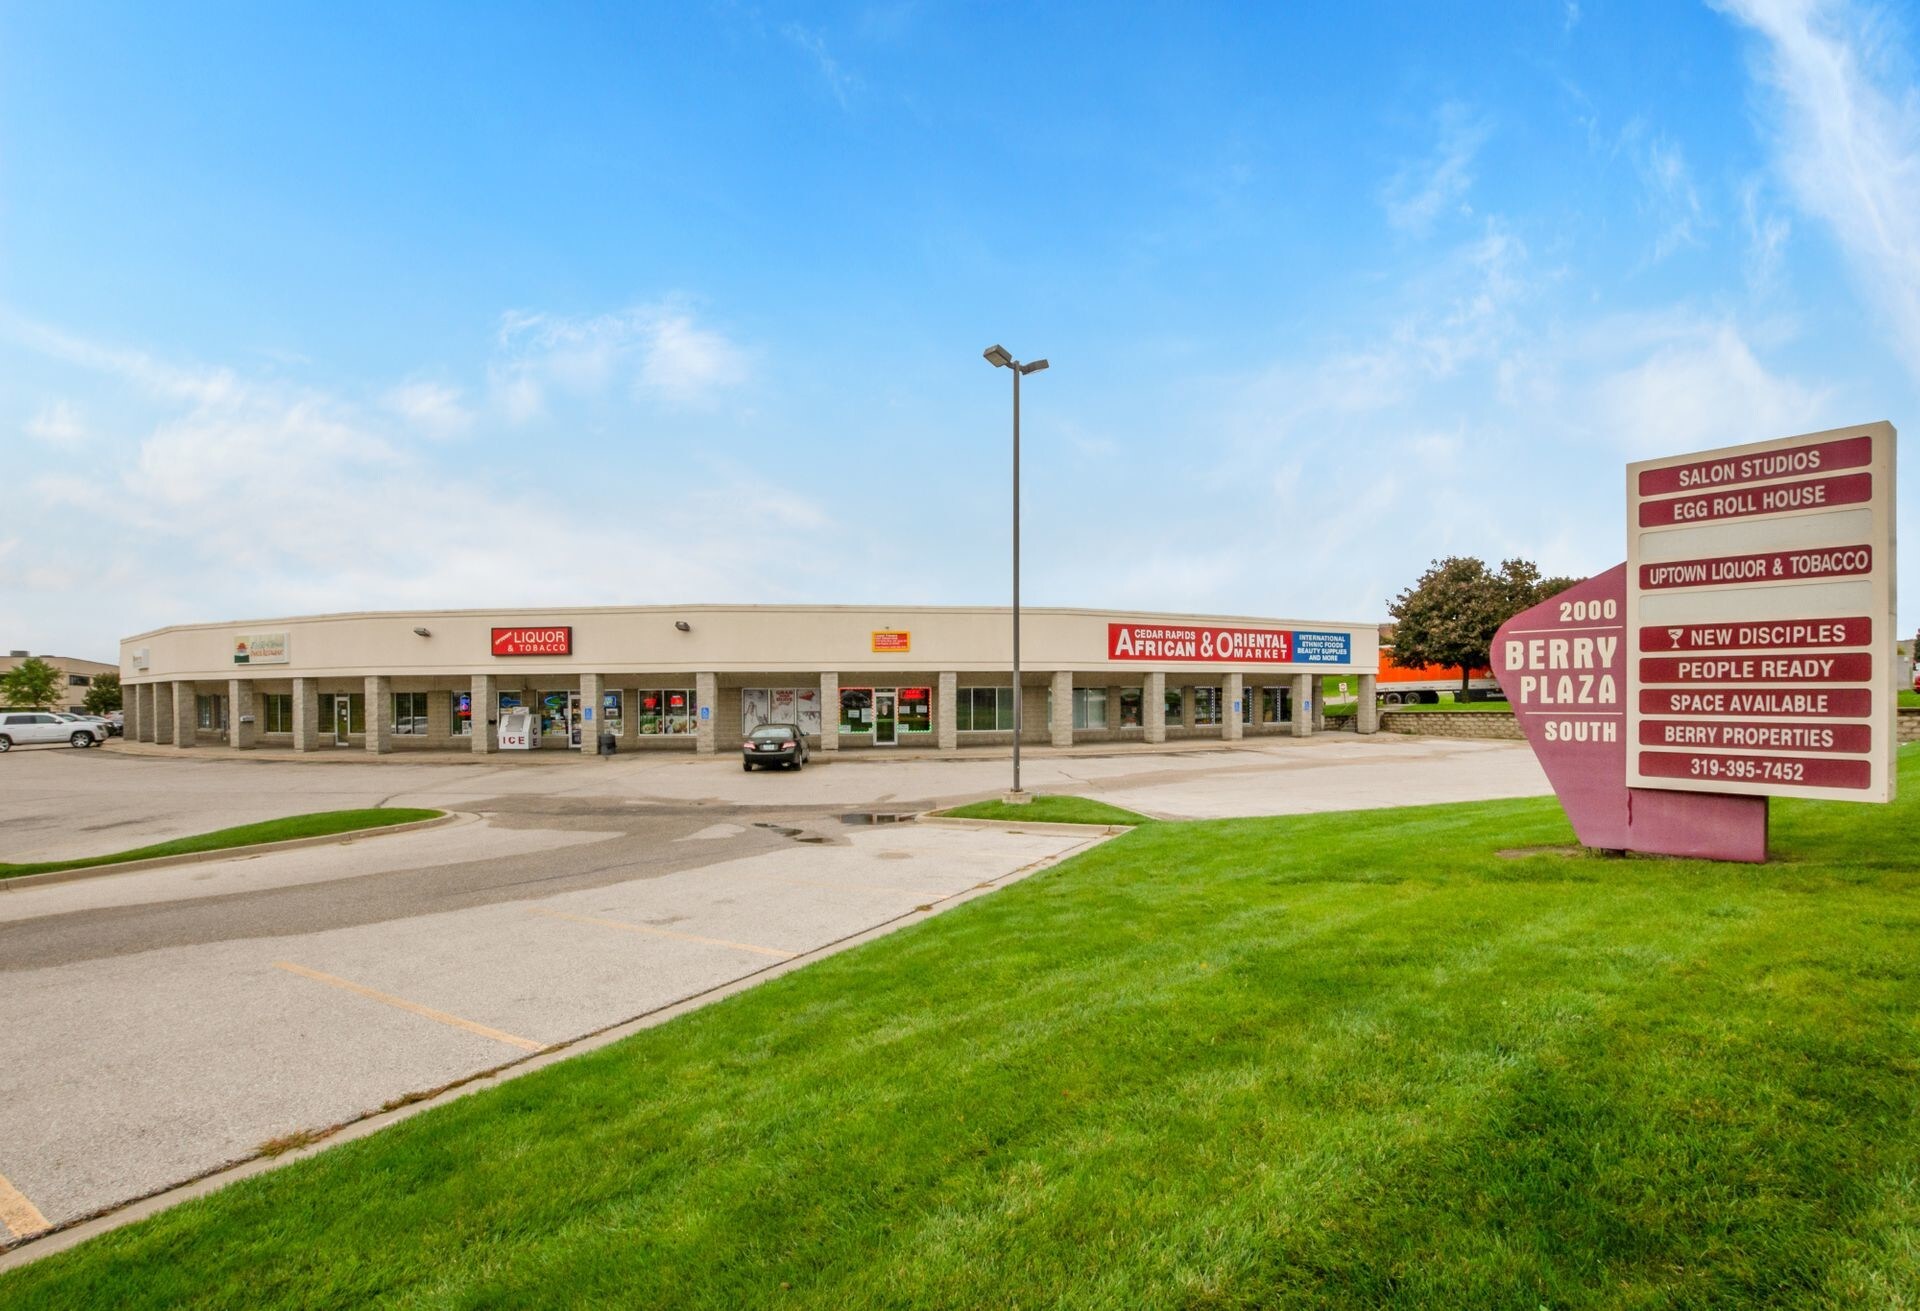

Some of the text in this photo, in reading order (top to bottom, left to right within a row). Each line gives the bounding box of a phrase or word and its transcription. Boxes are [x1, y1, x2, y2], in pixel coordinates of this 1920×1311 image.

[1679, 450, 1820, 487] SALON STUDIOS
[1674, 485, 1825, 520] EGG ROLL HOUSE
[1650, 550, 1868, 585] UPTOWN LIQUOR & TOBACCO
[1560, 599, 1617, 621] 2000
[514, 632, 564, 643] LIQUOR
[1115, 629, 1287, 657] AFRICAN & ORIENTAL
[1135, 629, 1196, 640] CEDAR RAPIDS
[1299, 634, 1345, 642] INTERNATIONAL
[1691, 625, 1846, 646] NEW DISCIPLES
[1234, 648, 1287, 659] MARKET
[1297, 647, 1347, 656] BEAUTY SUPPLIES
[1505, 636, 1617, 671] BERRY
[1679, 660, 1835, 679] PEOPLE READY
[1520, 674, 1617, 704] PLAZA
[1670, 694, 1828, 712] SPACE AVAILABLE
[1545, 721, 1617, 742] SOUTH
[1665, 726, 1833, 747] BERRY PROPERTIES
[1691, 759, 1803, 781] 319-395-7452
